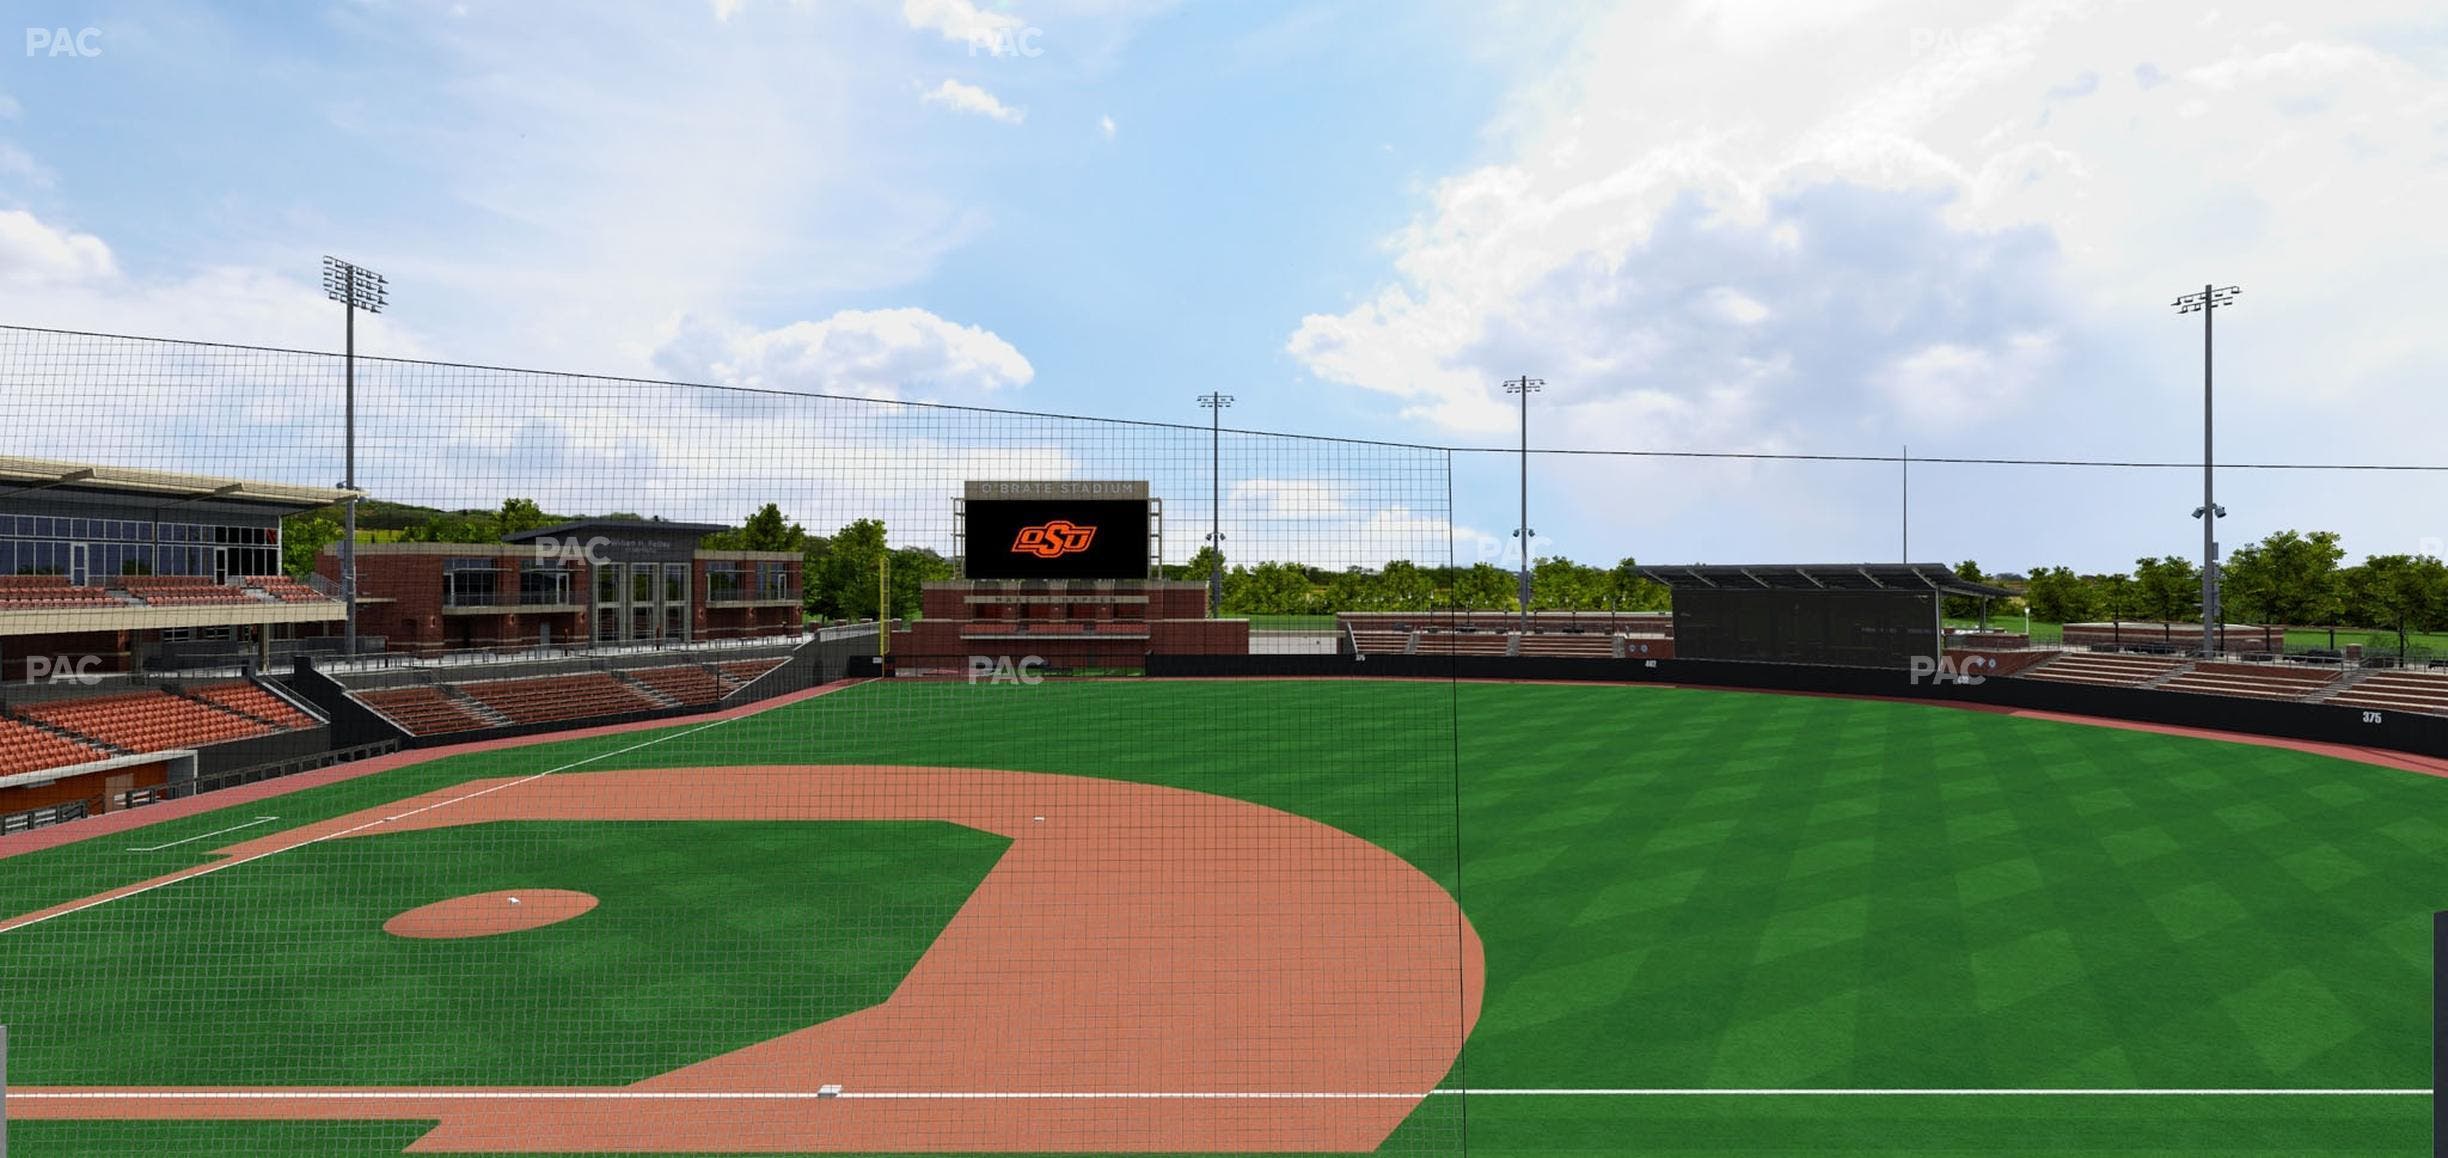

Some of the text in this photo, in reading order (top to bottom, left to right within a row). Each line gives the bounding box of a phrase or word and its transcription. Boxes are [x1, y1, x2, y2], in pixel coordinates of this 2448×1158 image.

[1060, 483, 1134, 494] STADIUM
[1011, 520, 1098, 558] OSU
[2362, 711, 2382, 724] 375
